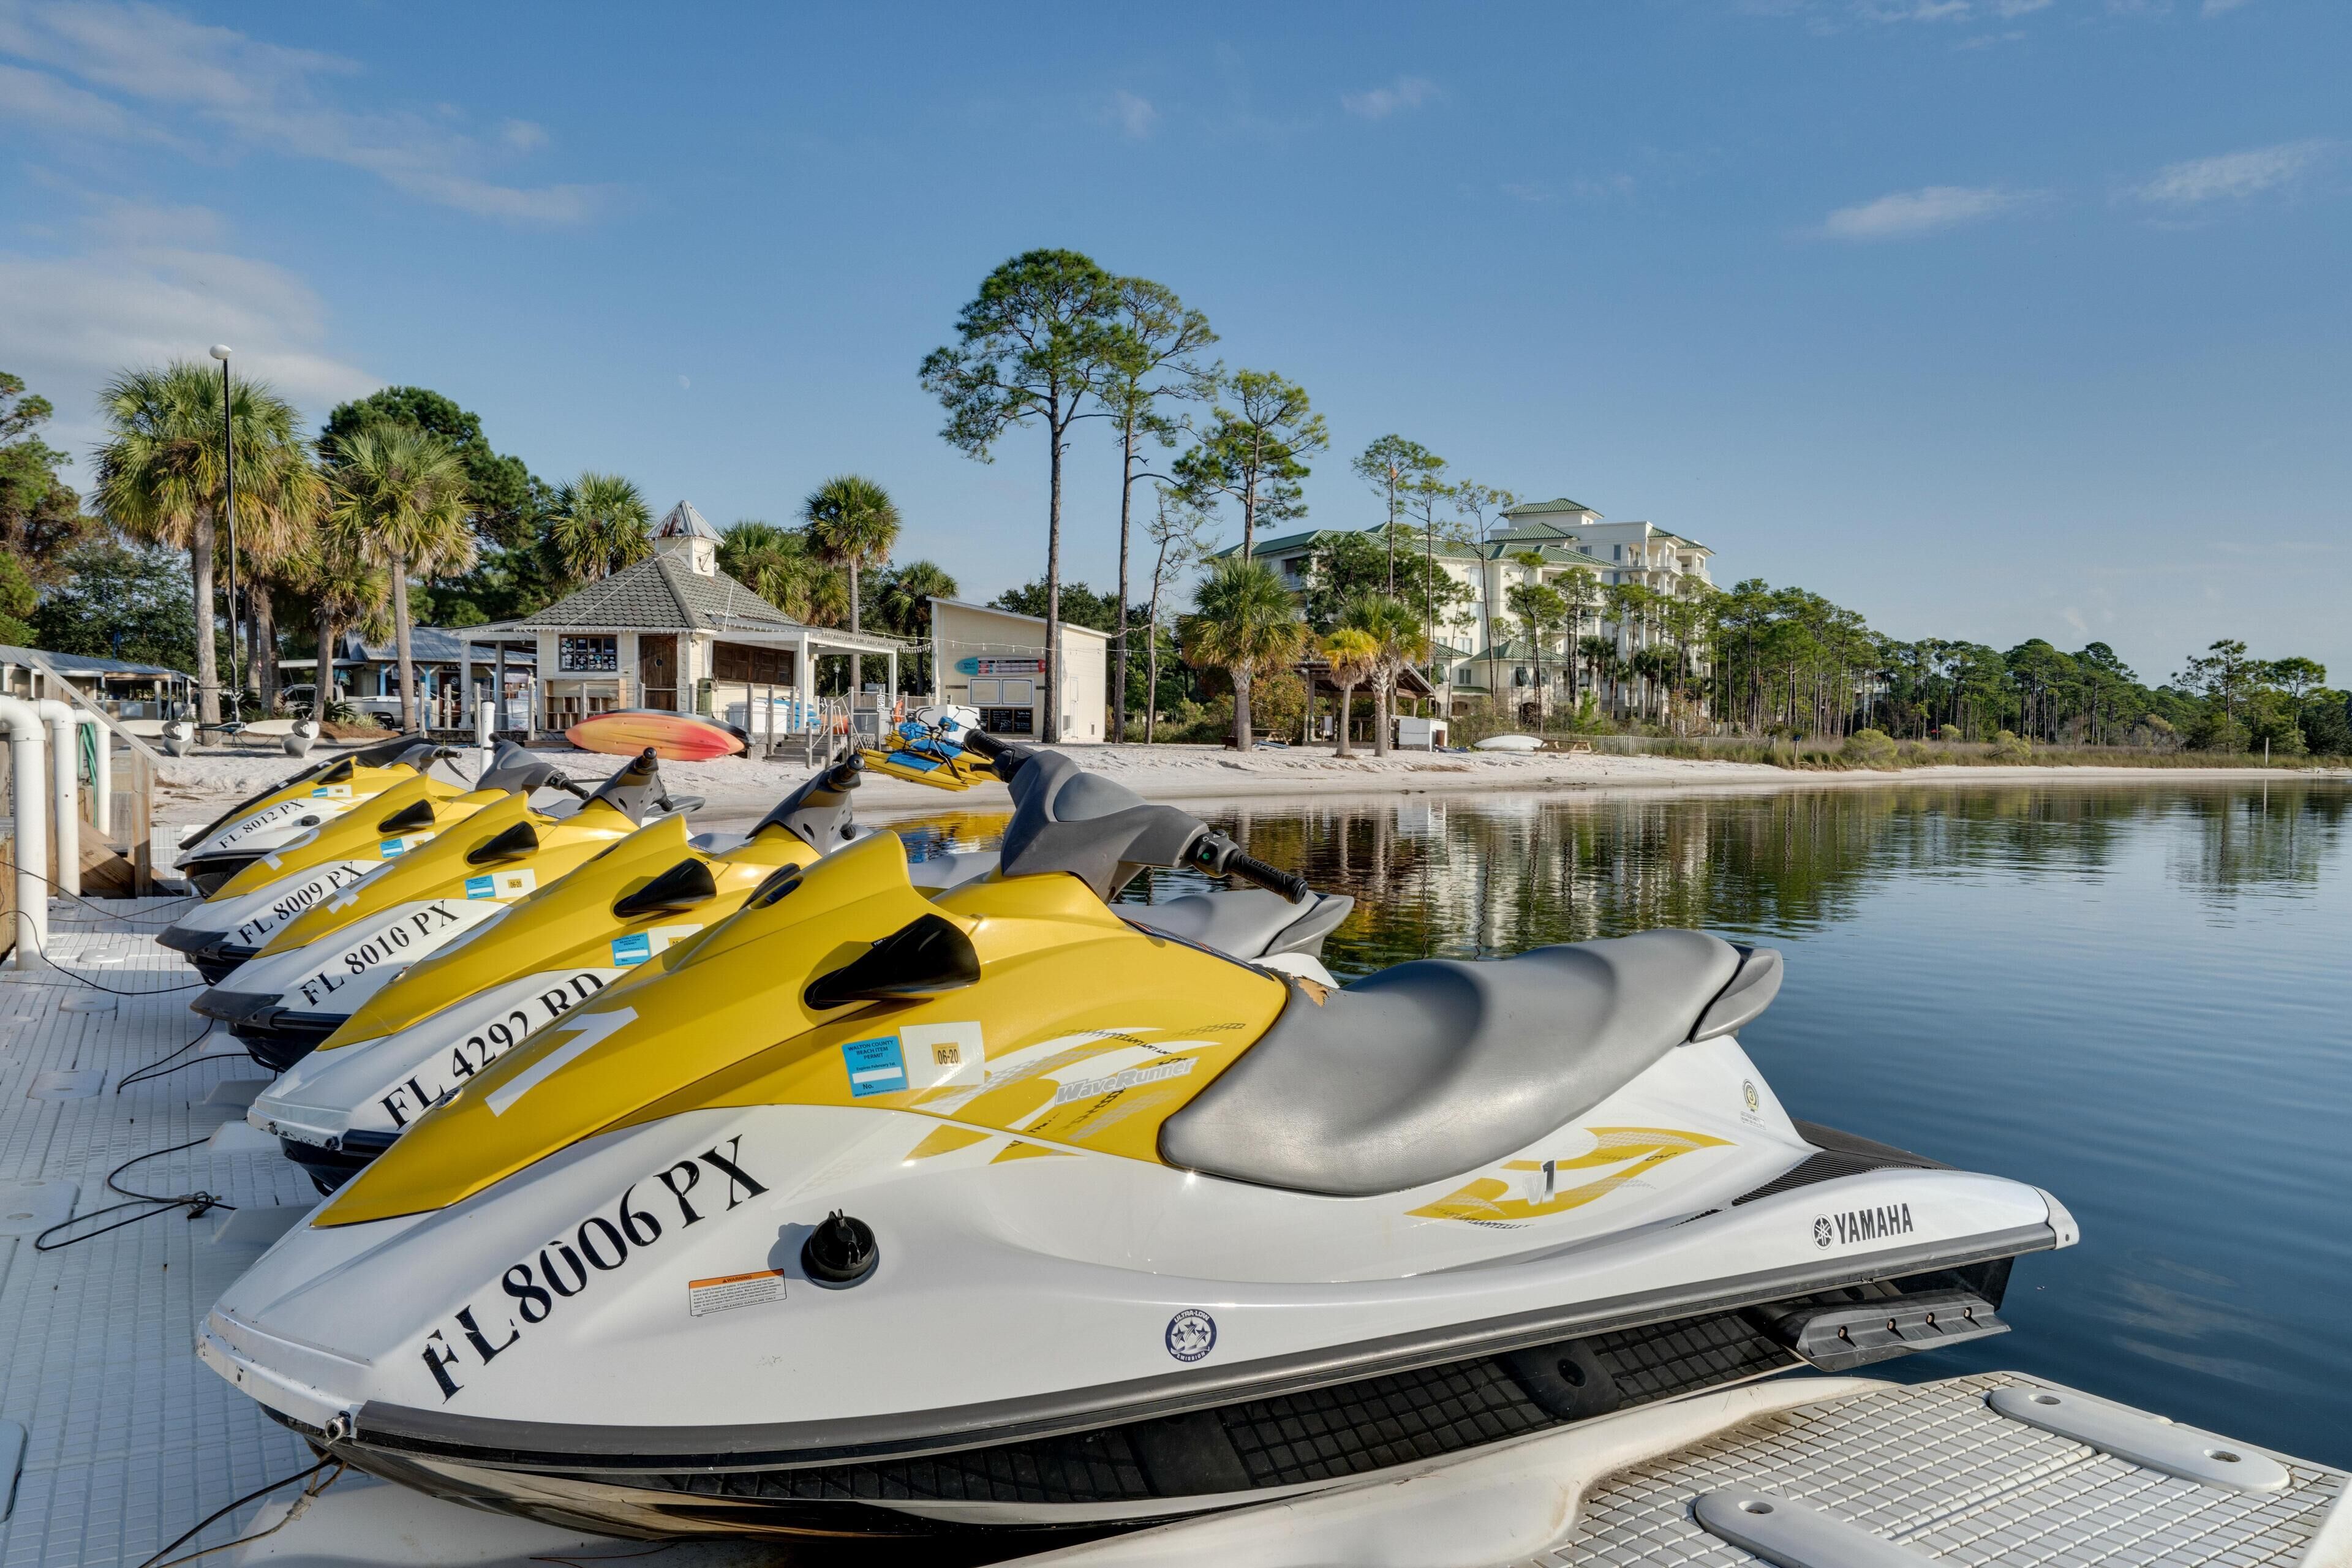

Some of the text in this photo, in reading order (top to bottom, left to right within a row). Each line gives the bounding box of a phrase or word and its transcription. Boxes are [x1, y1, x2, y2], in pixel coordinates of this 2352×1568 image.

[219, 799, 305, 849] FL 8012 PX
[237, 861, 363, 946] FL 8009 PX
[297, 899, 460, 1008] FL 8010 PX
[938, 1049, 959, 1065] 06-20
[1055, 1057, 1199, 1106] WaveRunner
[378, 1074, 444, 1131] FL
[1833, 1202, 1913, 1245] YAMAHA
[1177, 1351, 1205, 1361] EMISSION
